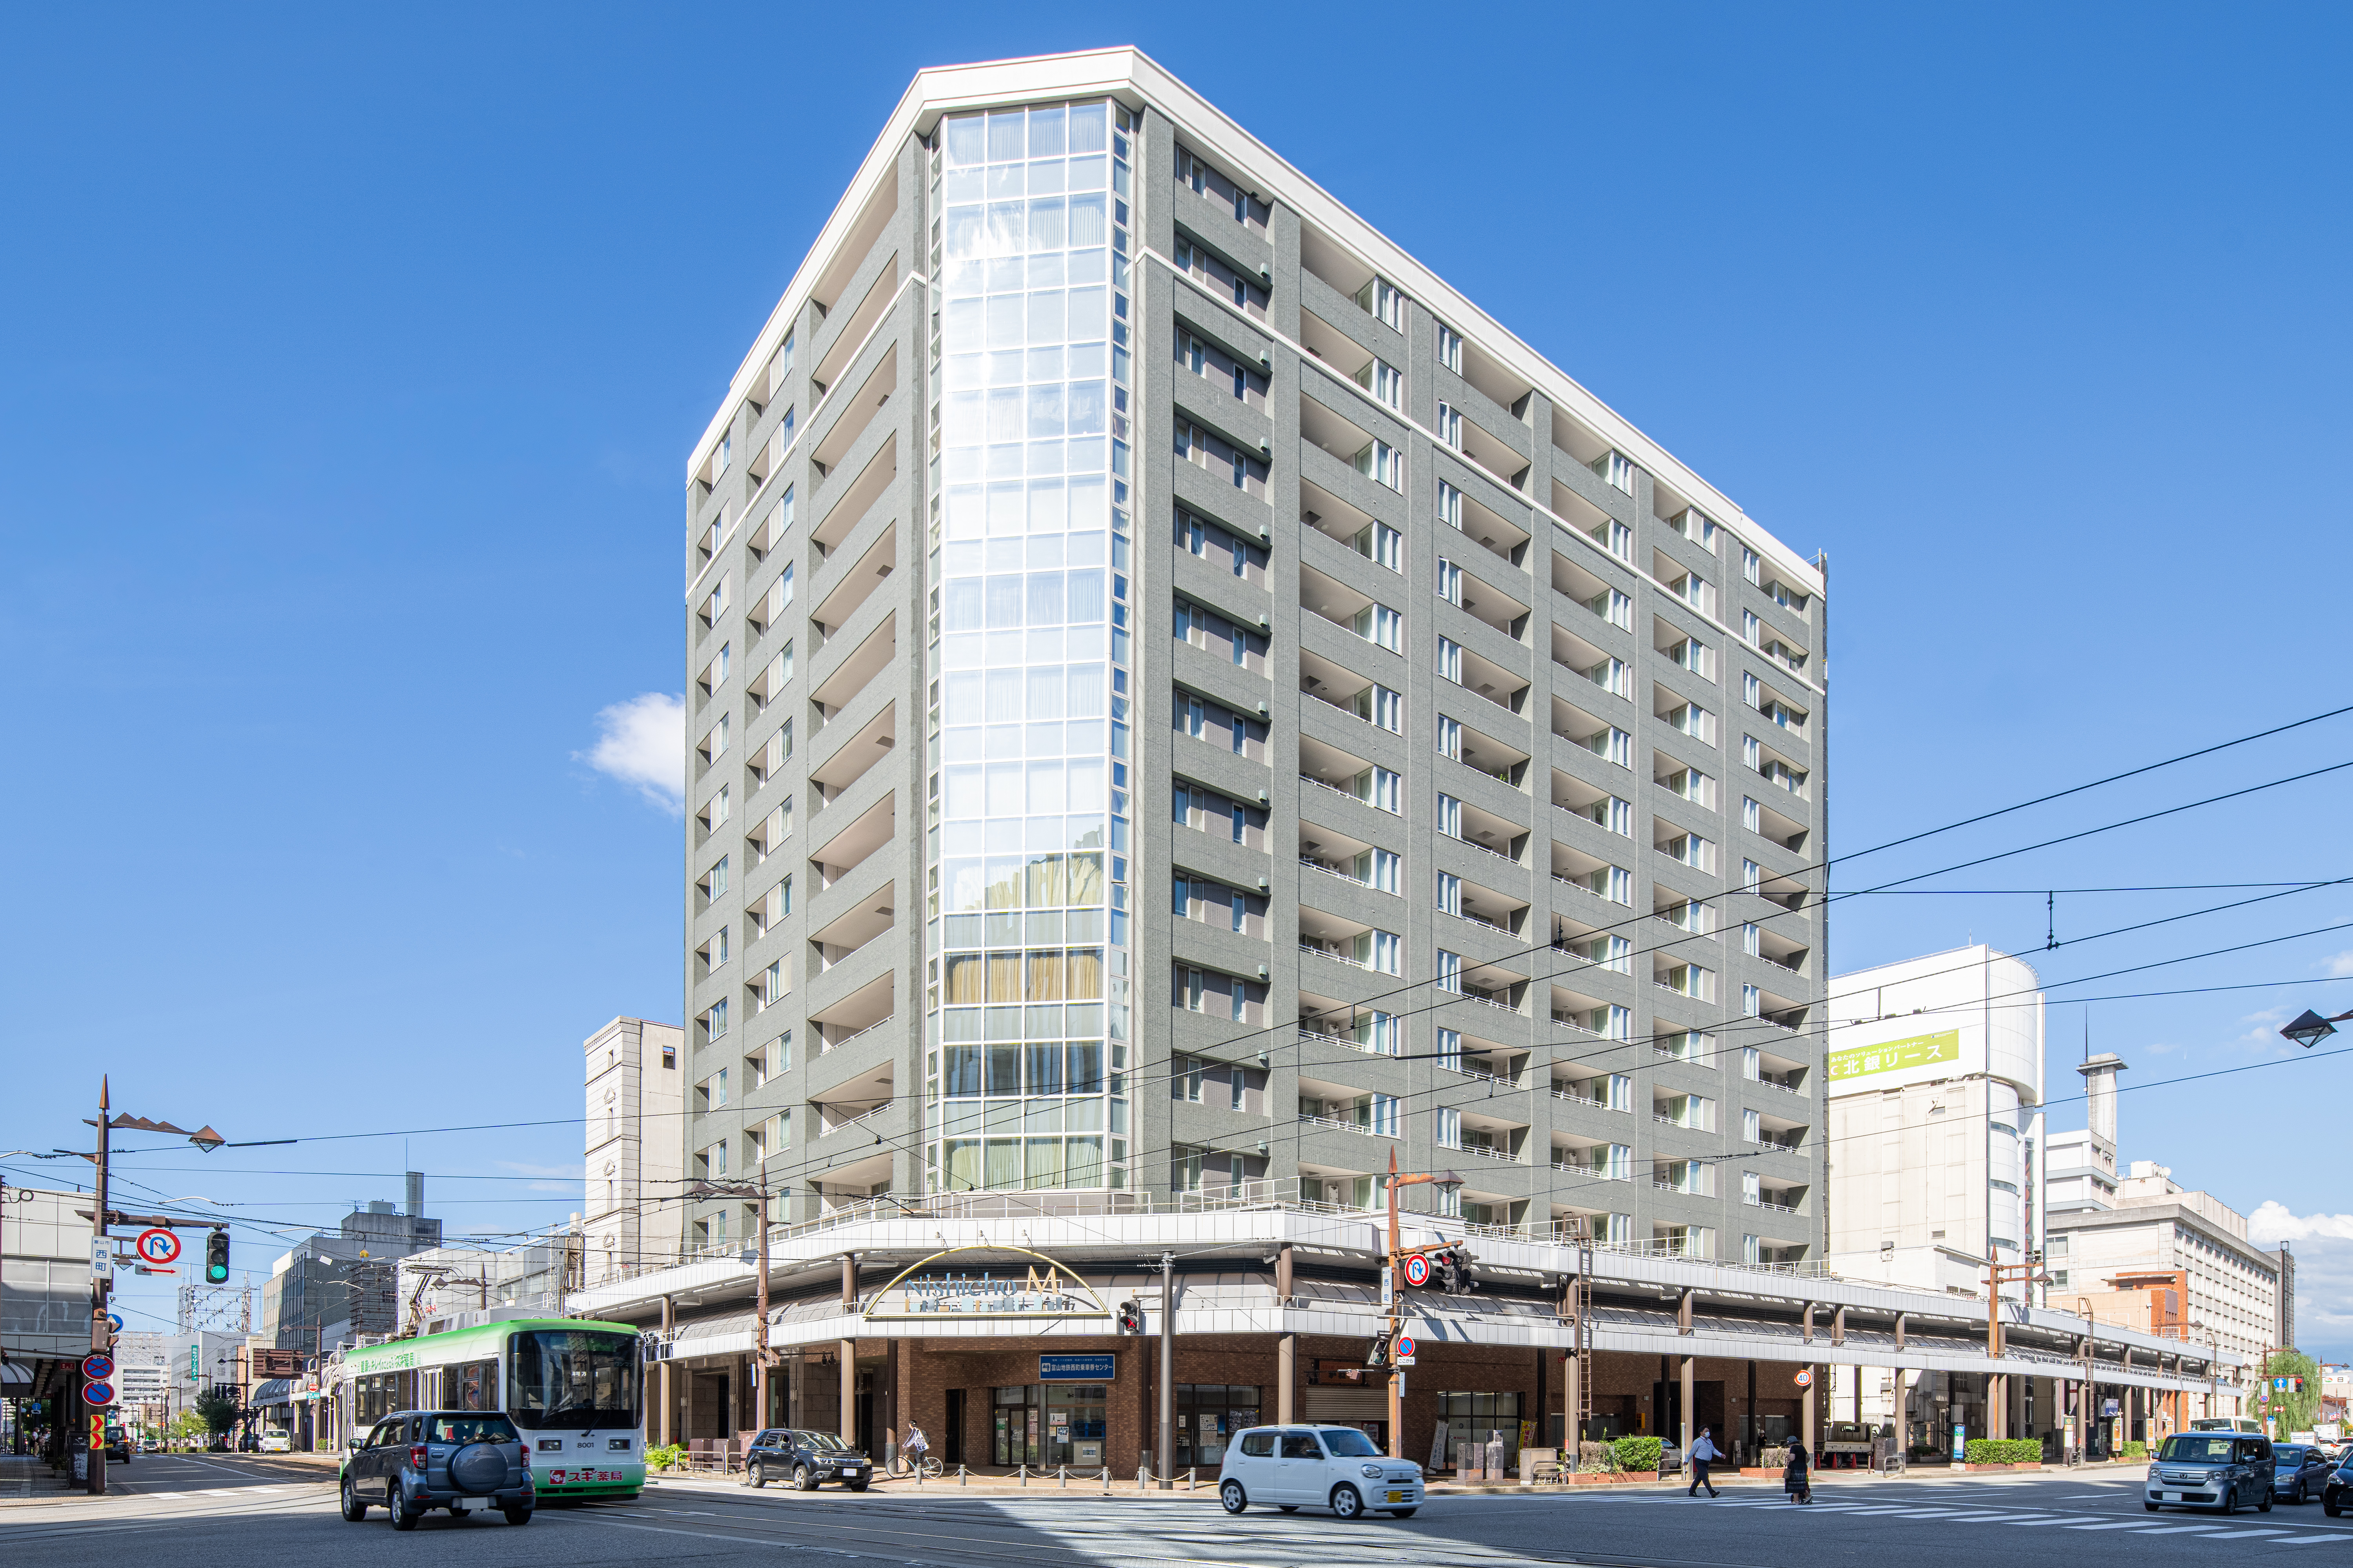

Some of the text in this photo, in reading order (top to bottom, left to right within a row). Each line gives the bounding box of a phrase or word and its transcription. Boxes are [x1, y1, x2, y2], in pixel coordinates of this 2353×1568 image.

[1831, 1041, 1924, 1063] あなたのソリューションパートナー
[1844, 1045, 1942, 1075] 北銀リース
[96, 1249, 107, 1271] 西町
[905, 1265, 1060, 1297] Nishicho M
[1384, 1279, 1389, 1301] 西町
[568, 1471, 623, 1482] スギ薬局
